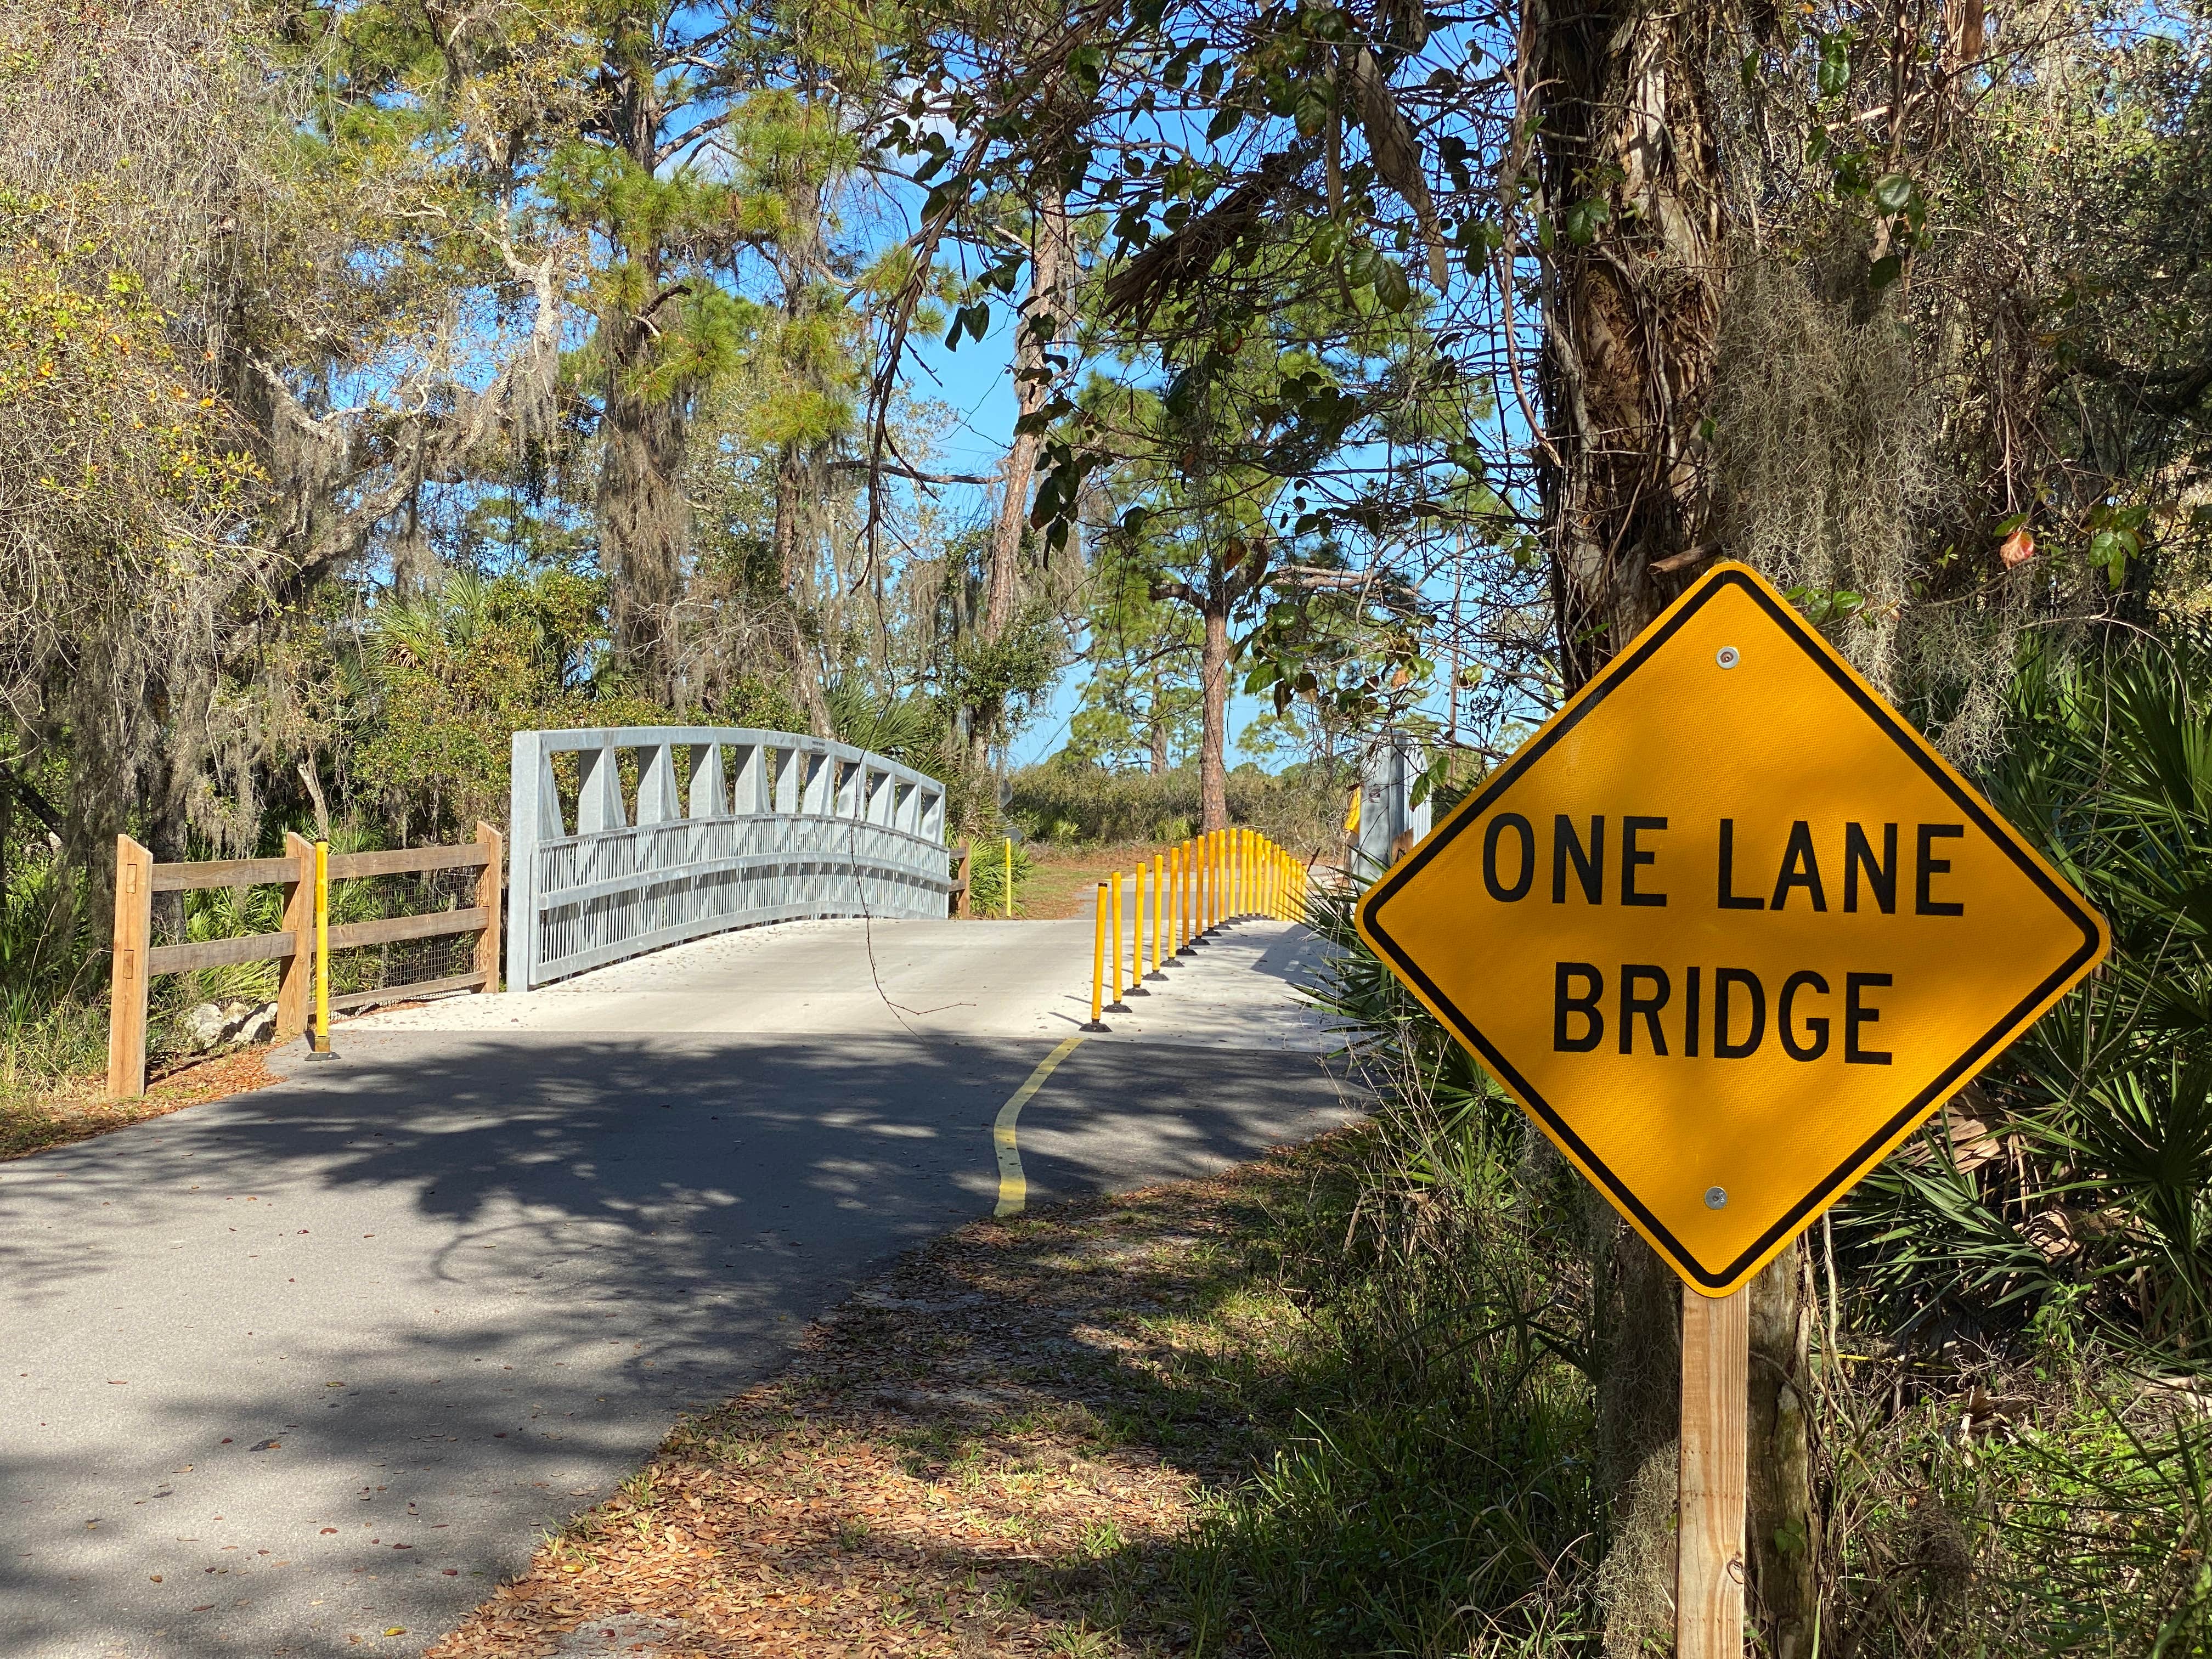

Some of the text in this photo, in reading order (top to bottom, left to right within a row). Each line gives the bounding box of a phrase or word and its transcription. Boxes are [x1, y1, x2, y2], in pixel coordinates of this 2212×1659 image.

[1483, 812, 1963, 916] ONE LANE
[1554, 962, 1892, 1065] BRIDGE
